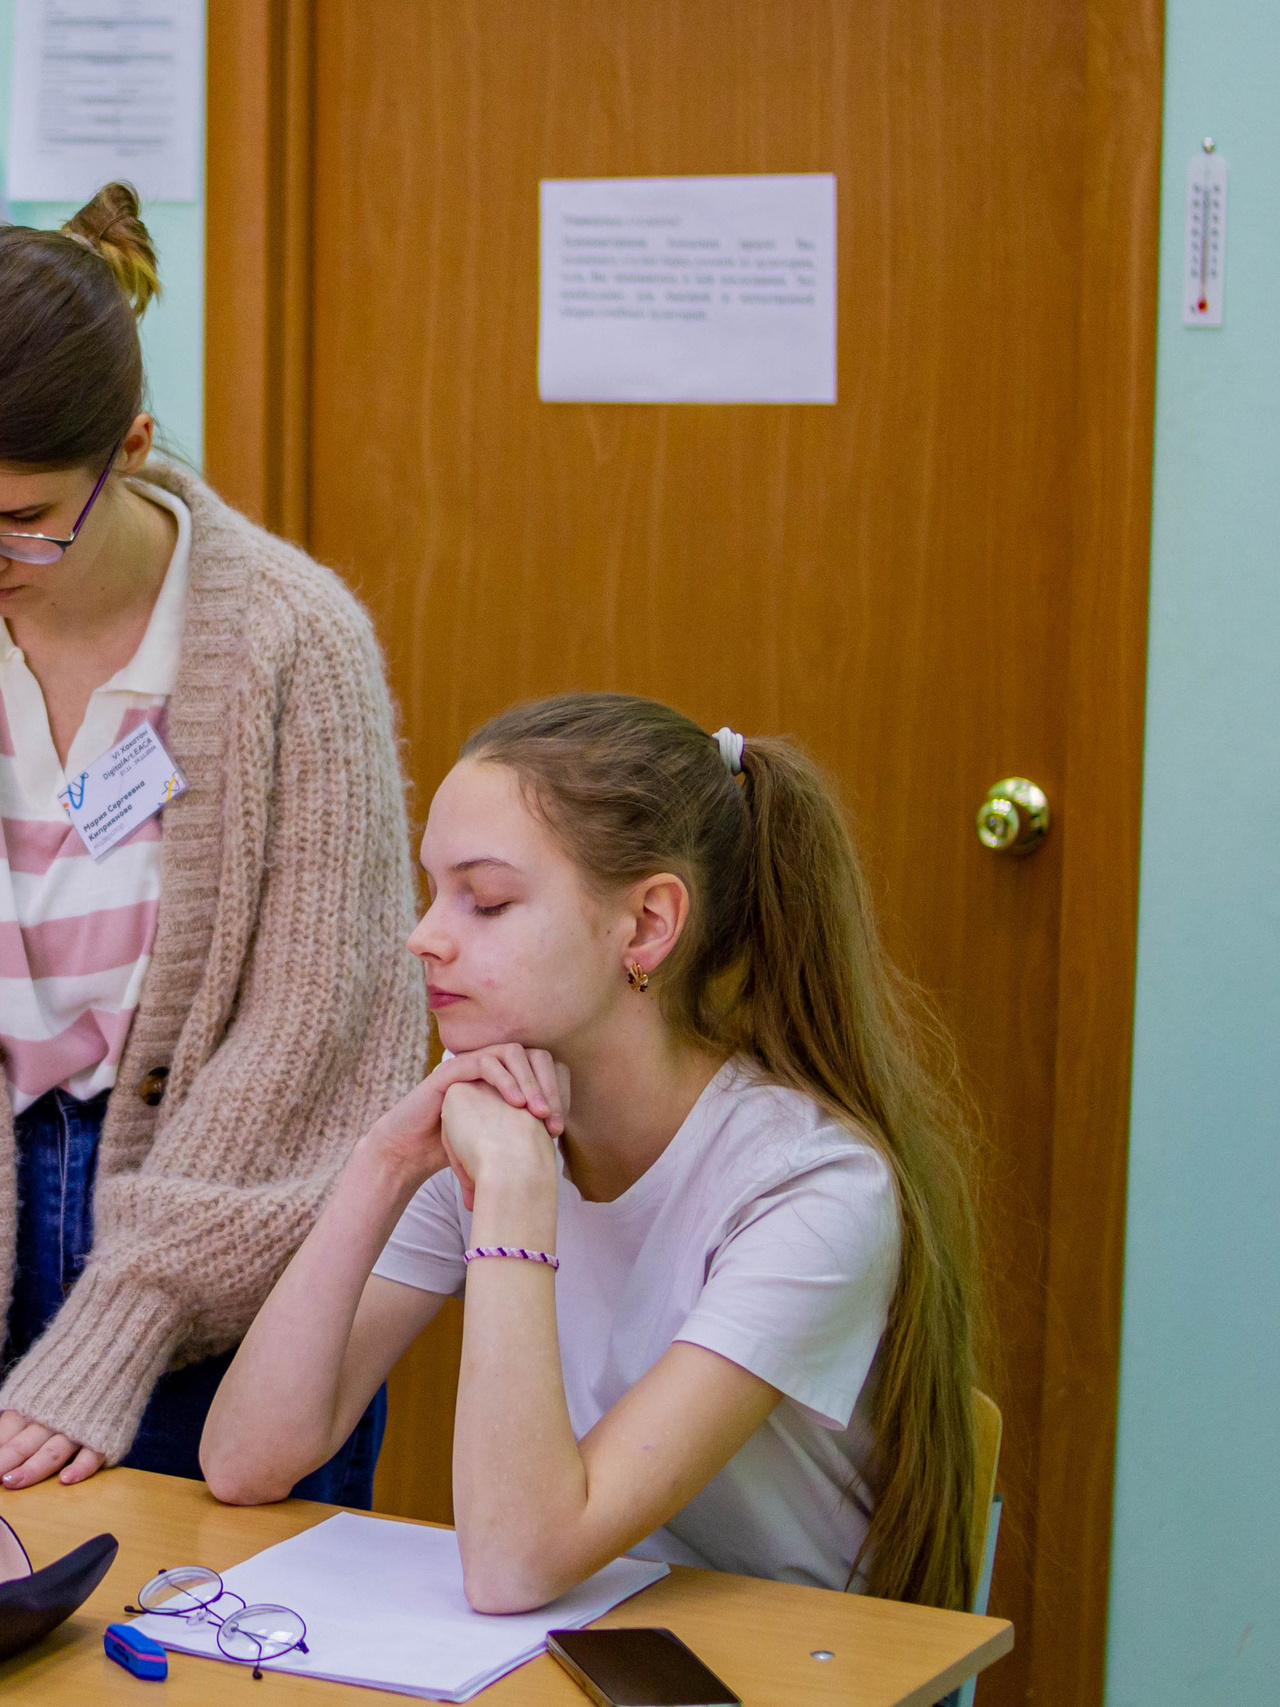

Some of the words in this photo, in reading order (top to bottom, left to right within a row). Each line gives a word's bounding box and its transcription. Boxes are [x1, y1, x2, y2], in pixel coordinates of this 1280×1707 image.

[120, 729, 148, 754] Хакатон
[83, 811, 108, 833] Мария
[107, 780, 146, 813] Сергеевна
[88, 804, 133, 842] Киприянова
